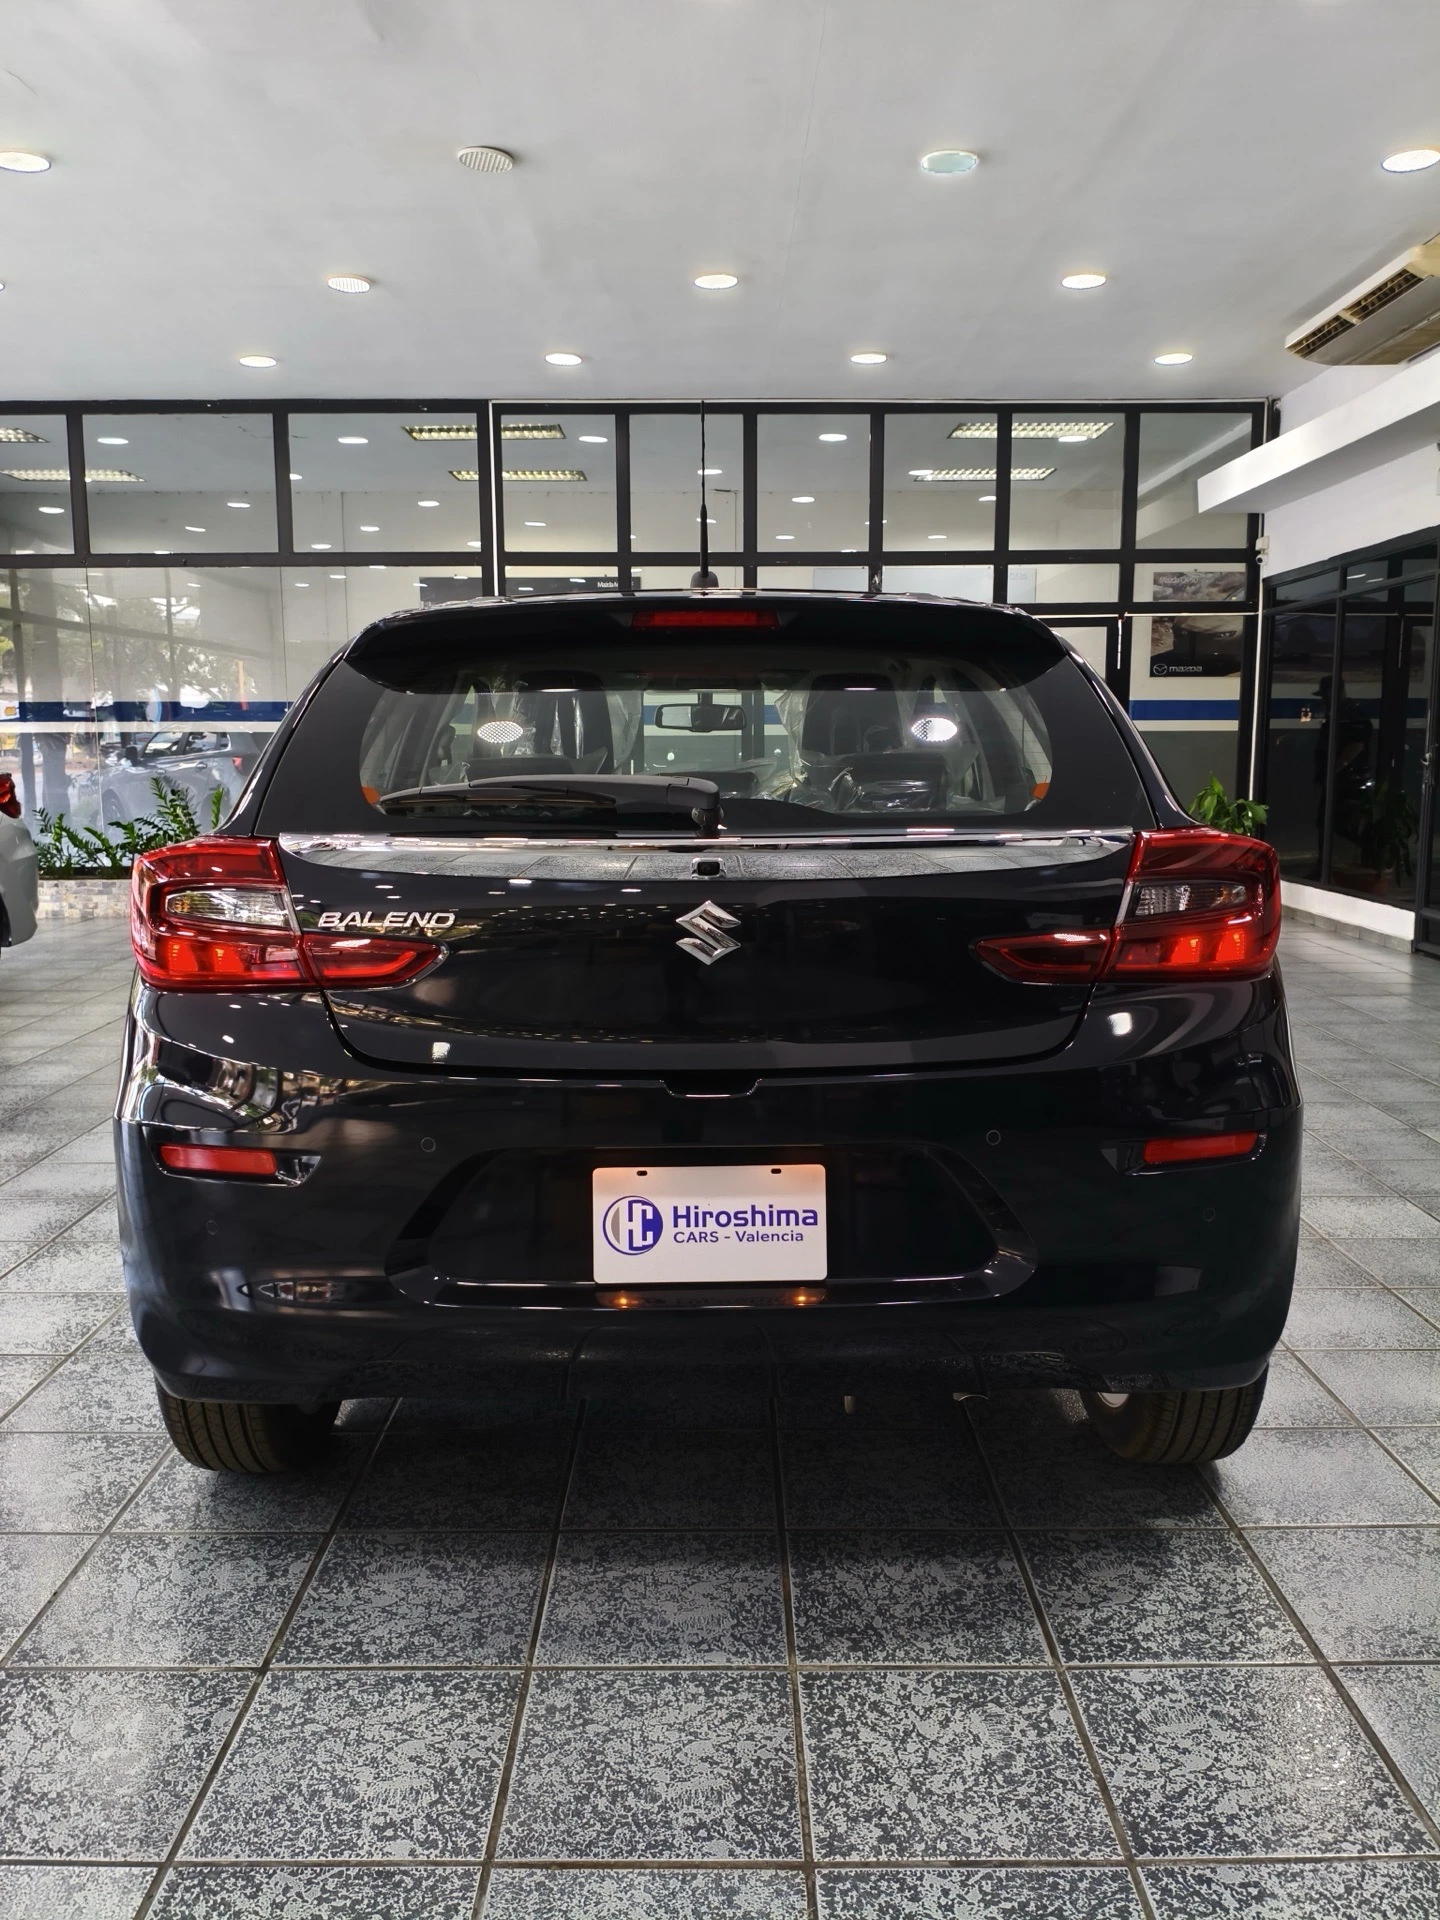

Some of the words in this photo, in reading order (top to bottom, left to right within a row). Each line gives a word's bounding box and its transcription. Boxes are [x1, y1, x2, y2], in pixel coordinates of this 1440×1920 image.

[317, 910, 456, 928] BALENO
[672, 1204, 818, 1228] Hiroshima
[673, 1231, 719, 1244] CARS
[735, 1230, 804, 1243] Valencia
